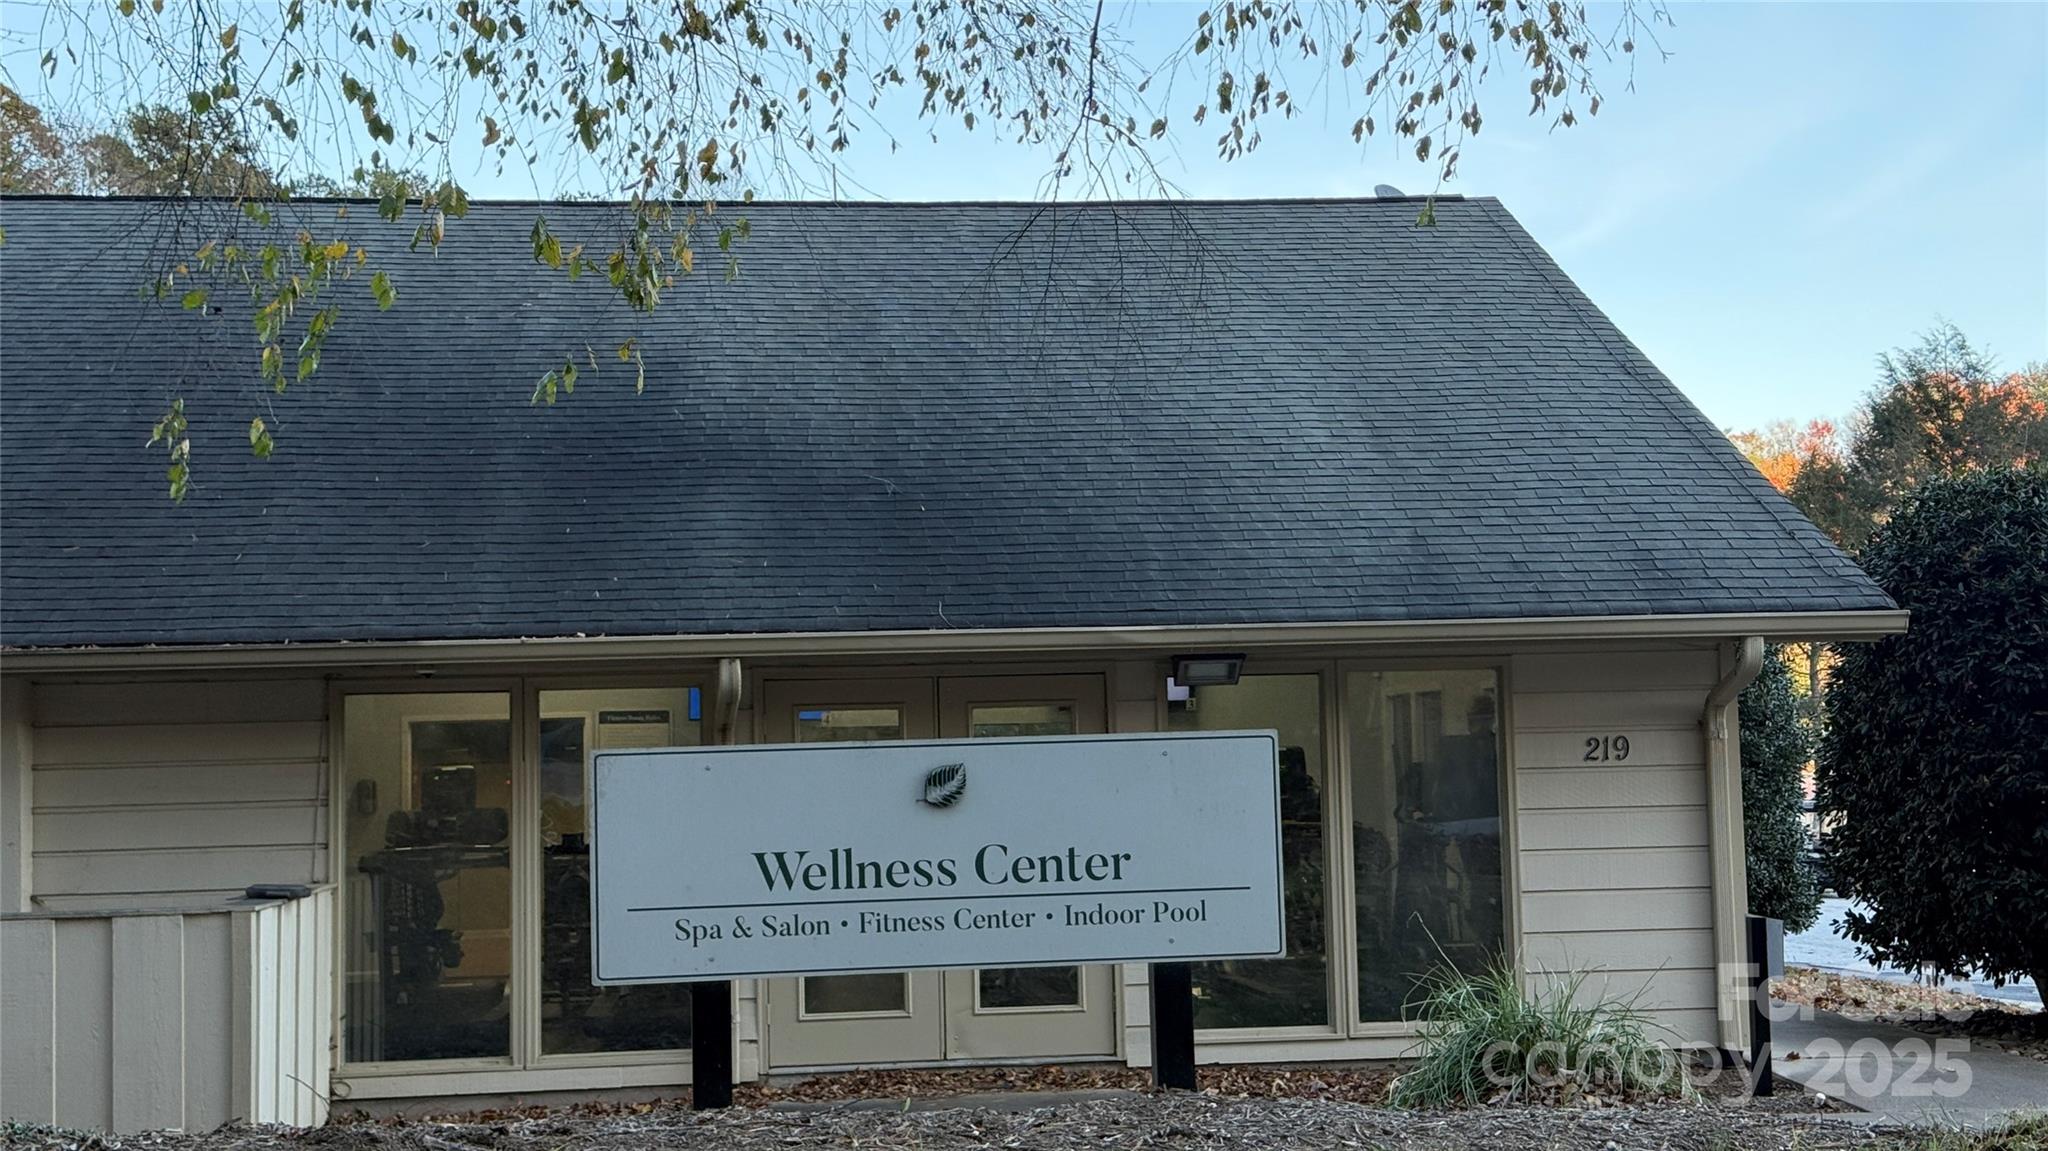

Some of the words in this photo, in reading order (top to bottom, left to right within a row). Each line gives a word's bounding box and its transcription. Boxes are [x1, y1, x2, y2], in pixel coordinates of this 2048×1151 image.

[1583, 735, 1630, 762] 219
[751, 848, 957, 891] Wellness
[974, 843, 1131, 885] Center
[674, 918, 723, 946] Spa
[732, 915, 753, 939] &
[761, 913, 831, 938] Salon
[859, 911, 945, 934] Fitness
[953, 907, 1036, 931] Center
[1064, 902, 1146, 927] Indoor
[1153, 899, 1207, 923] Pool
